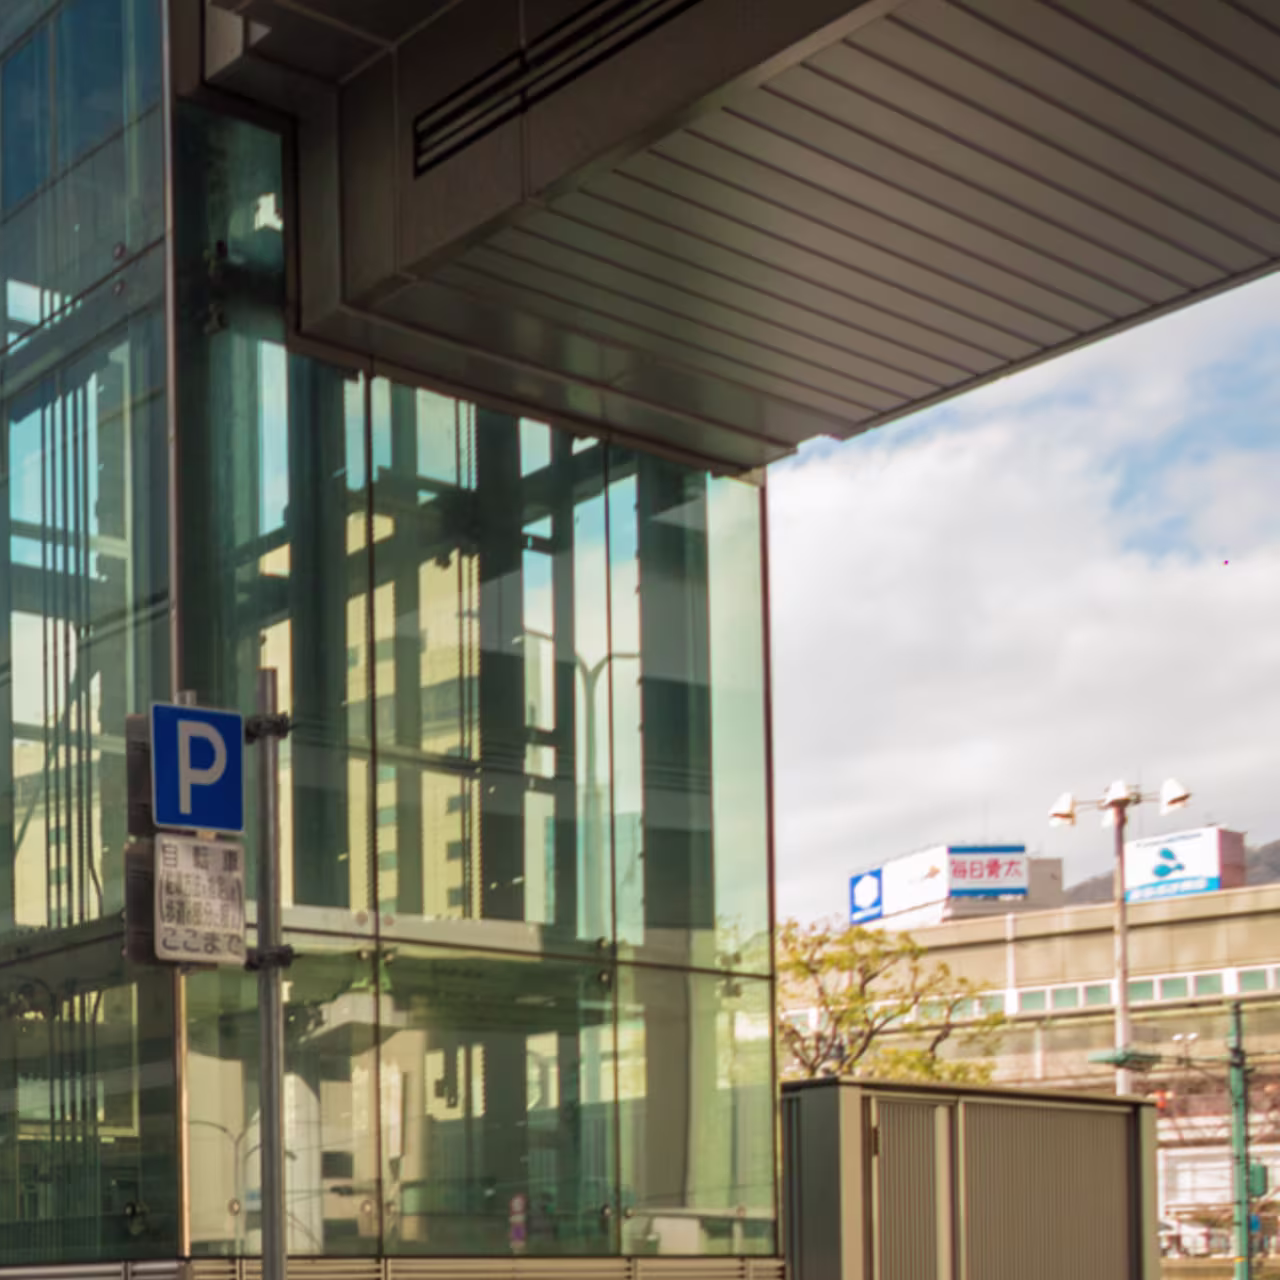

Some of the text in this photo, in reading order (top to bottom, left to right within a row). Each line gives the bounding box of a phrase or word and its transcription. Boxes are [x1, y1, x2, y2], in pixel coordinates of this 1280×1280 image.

[177, 719, 228, 815] P
[161, 926, 243, 956] ここまで
